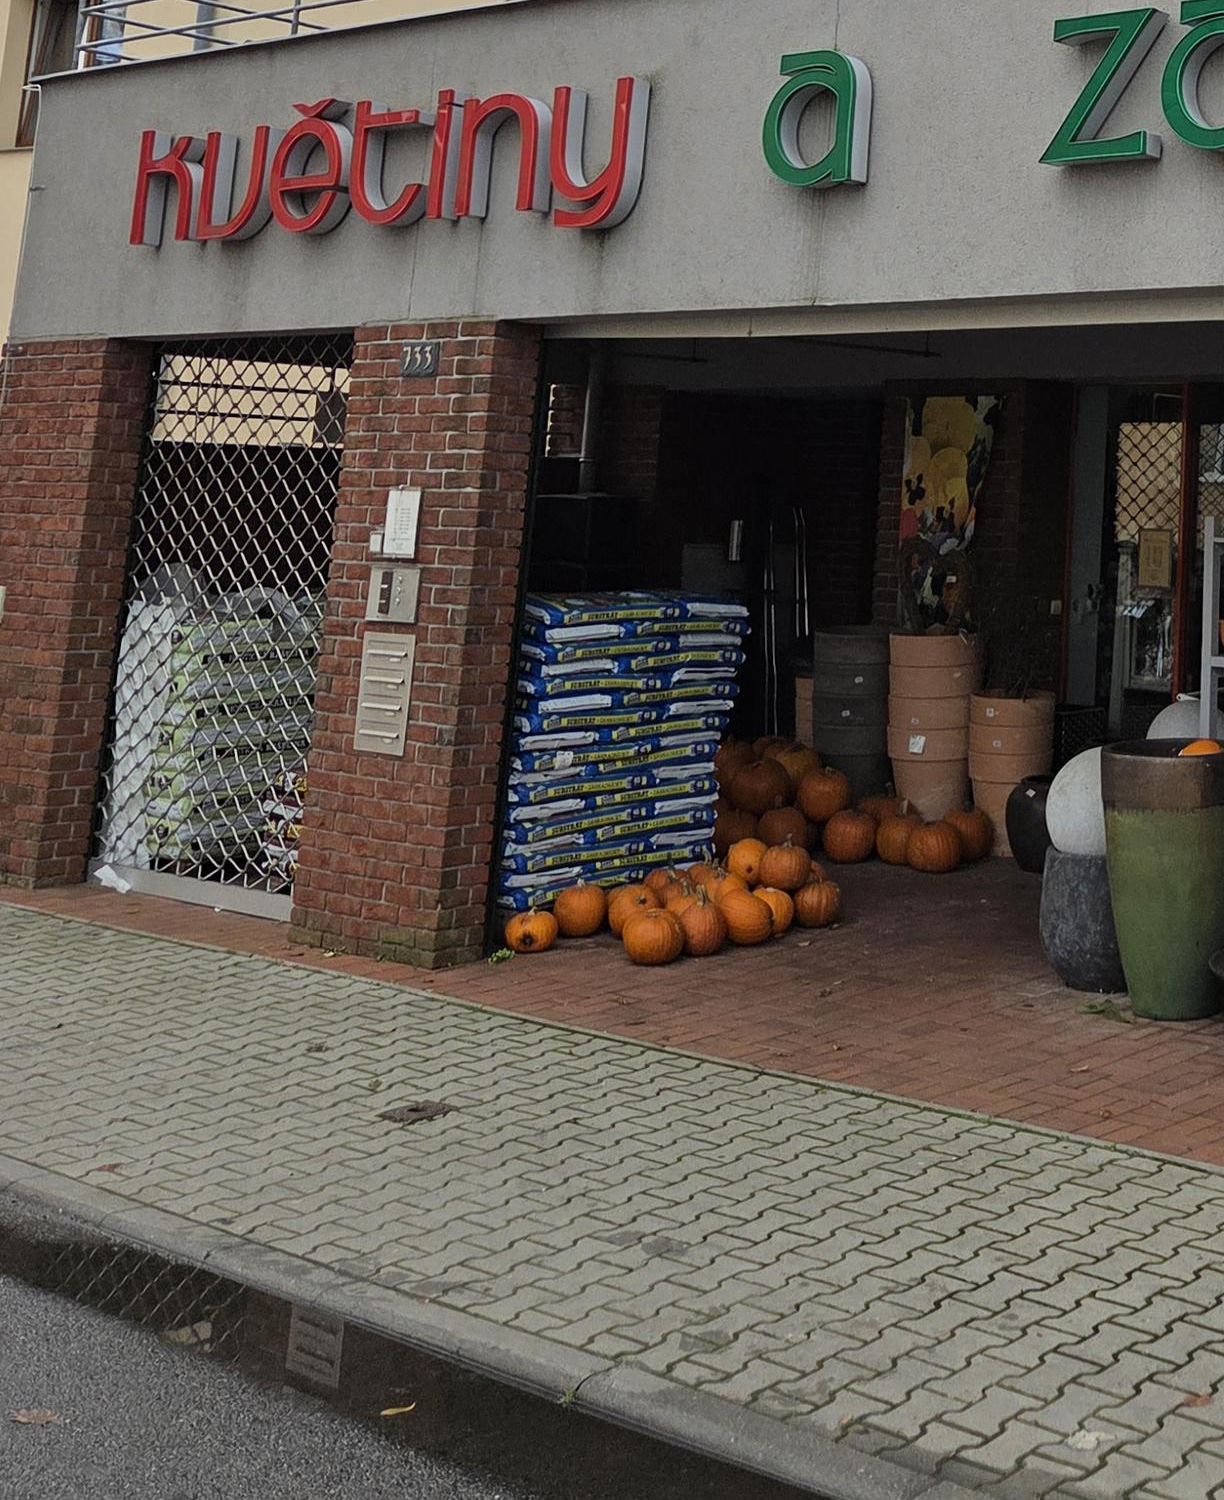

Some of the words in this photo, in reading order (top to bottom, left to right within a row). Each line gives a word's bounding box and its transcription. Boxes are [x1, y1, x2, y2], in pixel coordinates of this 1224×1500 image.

[129, 76, 650, 245] květiny
[762, 48, 871, 188] a
[403, 345, 432, 370] 733
